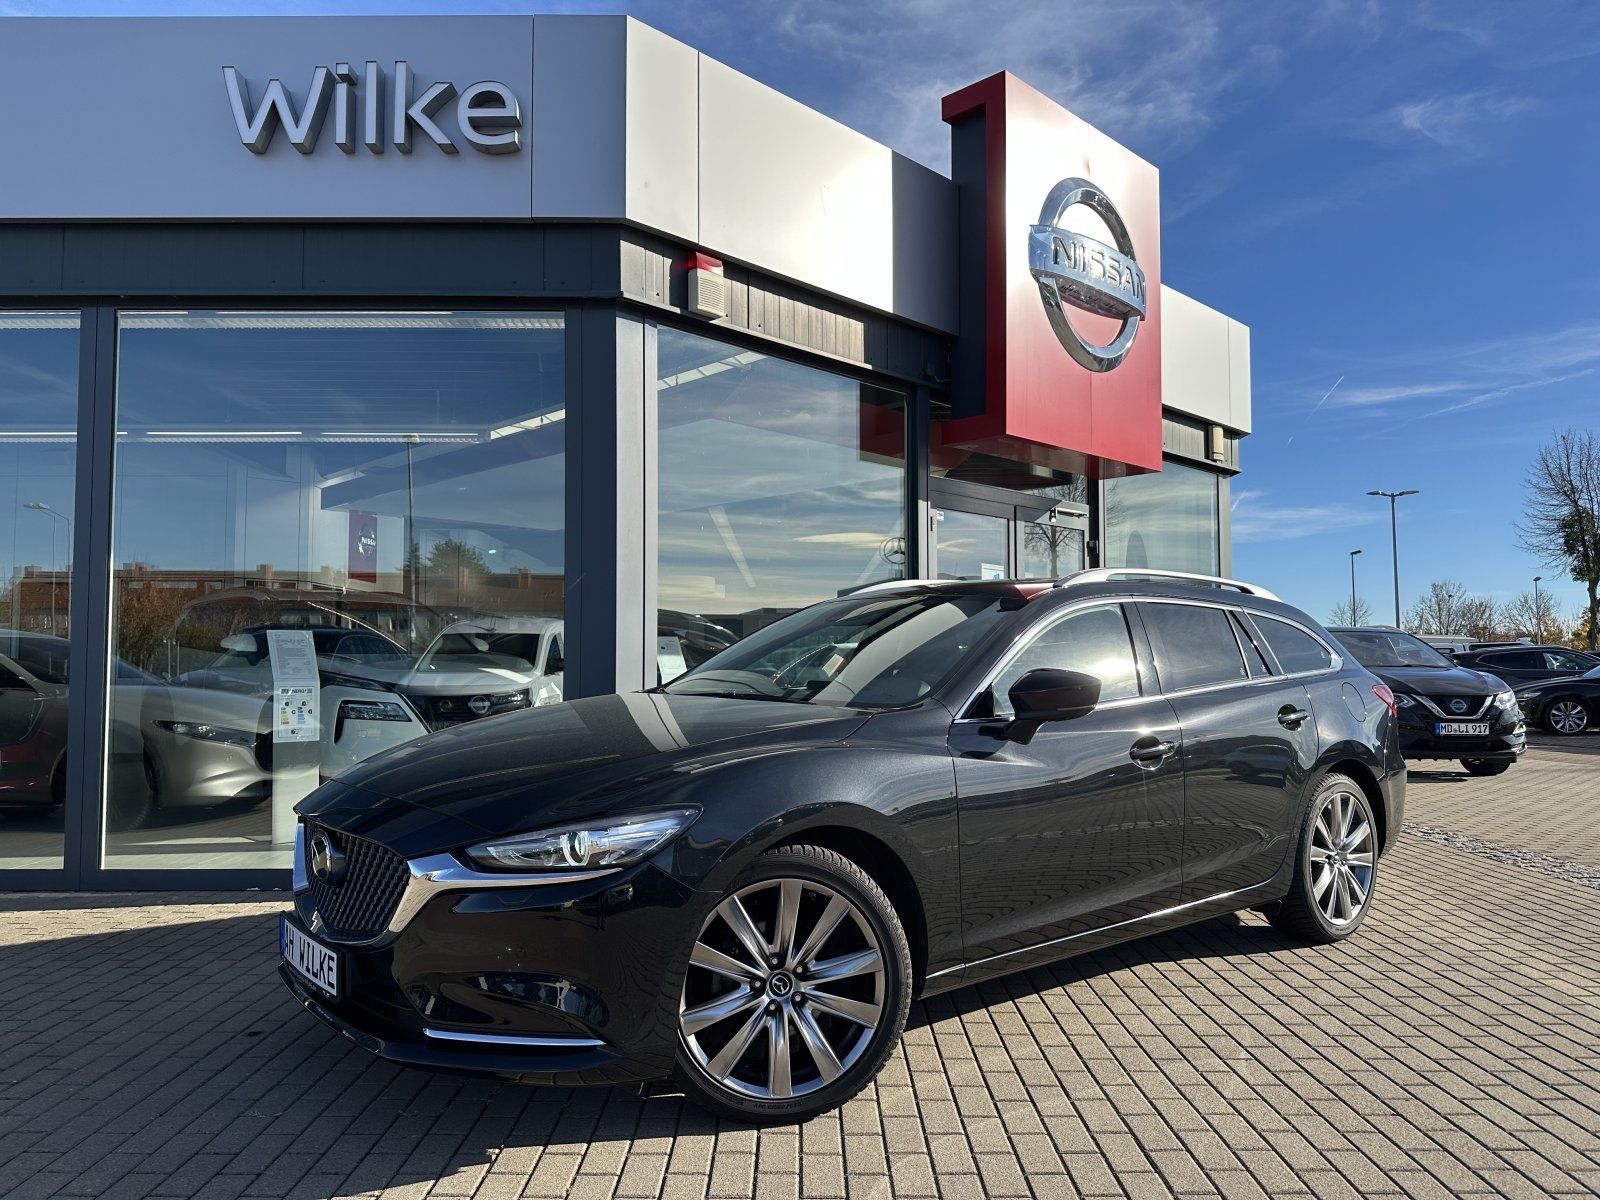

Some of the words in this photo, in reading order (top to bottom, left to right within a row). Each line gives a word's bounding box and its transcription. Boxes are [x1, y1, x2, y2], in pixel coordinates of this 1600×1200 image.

[222, 60, 522, 154] Wilke
[1052, 236, 1146, 306] NISSAN
[1440, 724, 1453, 733] MD
[1458, 724, 1470, 733] LI
[1471, 724, 1488, 734] 917
[300, 935, 336, 990] WILKE
